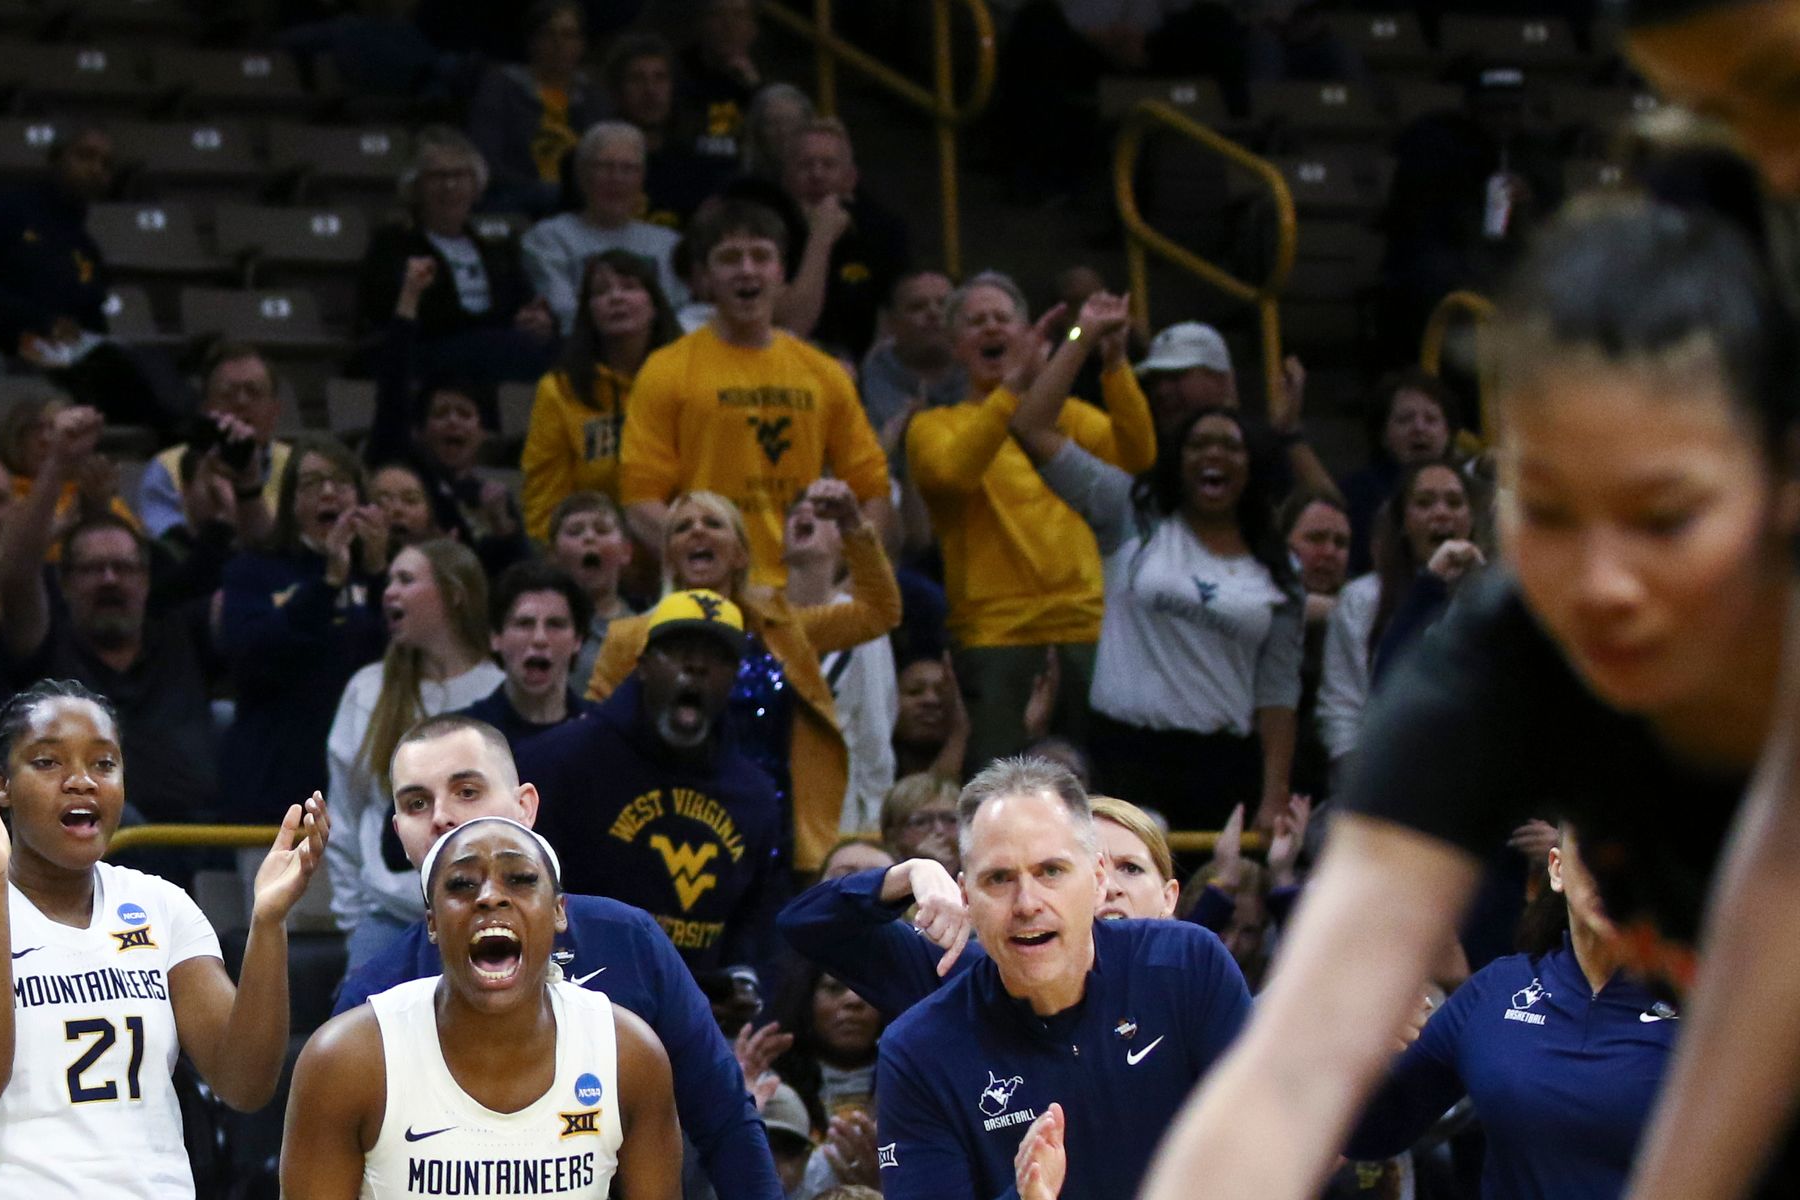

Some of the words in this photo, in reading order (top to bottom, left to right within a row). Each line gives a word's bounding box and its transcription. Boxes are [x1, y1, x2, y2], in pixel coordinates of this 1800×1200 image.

[608, 788, 664, 844] WEST
[672, 787, 746, 864] VIRGINIA
[13, 967, 167, 1010] MOUNTAINEERS
[1504, 1008, 1546, 1026] BASKETBALL
[63, 1015, 144, 1106] 21
[985, 1108, 1035, 1133] BASKETBALL
[408, 1152, 594, 1197] MOUNTAINEERS
